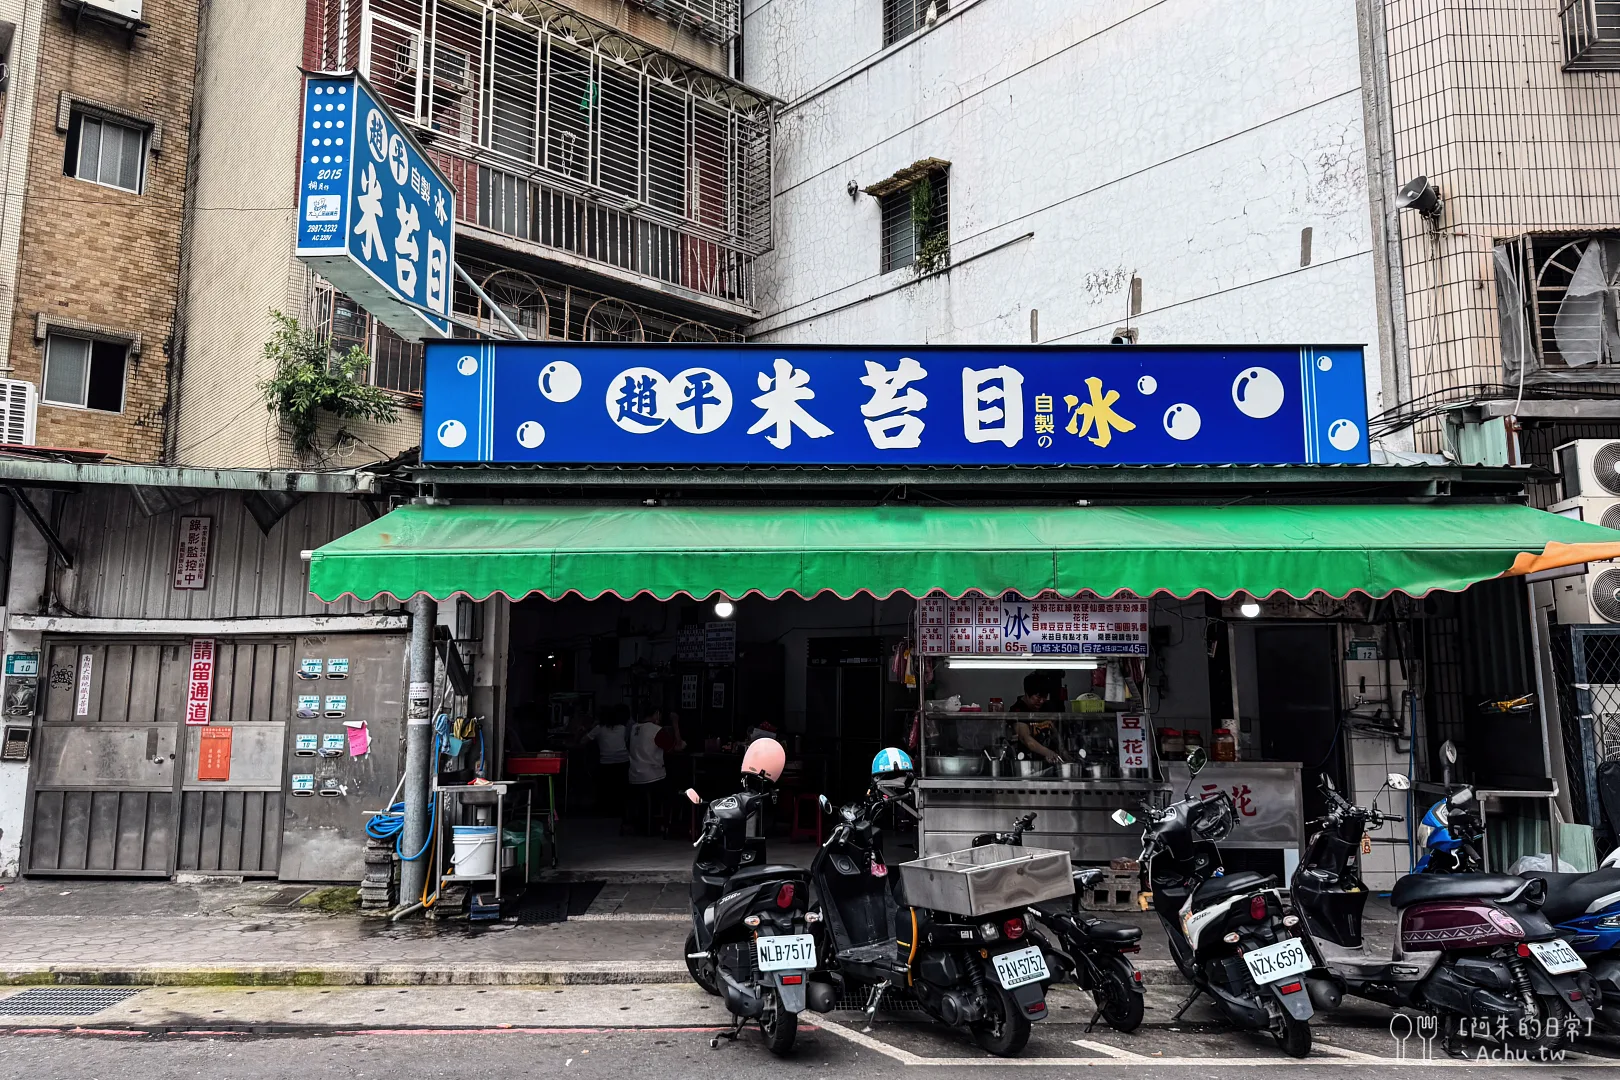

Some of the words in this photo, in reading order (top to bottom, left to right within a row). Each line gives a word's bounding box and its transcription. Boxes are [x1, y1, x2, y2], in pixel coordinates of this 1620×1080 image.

[368, 110, 408, 183] 趙平
[317, 169, 343, 180] 2015
[410, 167, 431, 206] 自製
[433, 188, 449, 227] 冰
[353, 160, 448, 321] 米苔目
[611, 369, 727, 431] 趙平
[746, 357, 1025, 451] 米苔目
[1034, 393, 1055, 449] 自製の
[1063, 376, 1136, 448] 冰
[184, 519, 202, 585] 錄影監控中
[1003, 606, 1031, 641] 冰
[1005, 642, 1028, 652] 65元
[1363, 651, 1372, 659] 12
[188, 640, 213, 722] 請留通道
[1121, 713, 1144, 754] 豆花
[1125, 756, 1143, 766] 45
